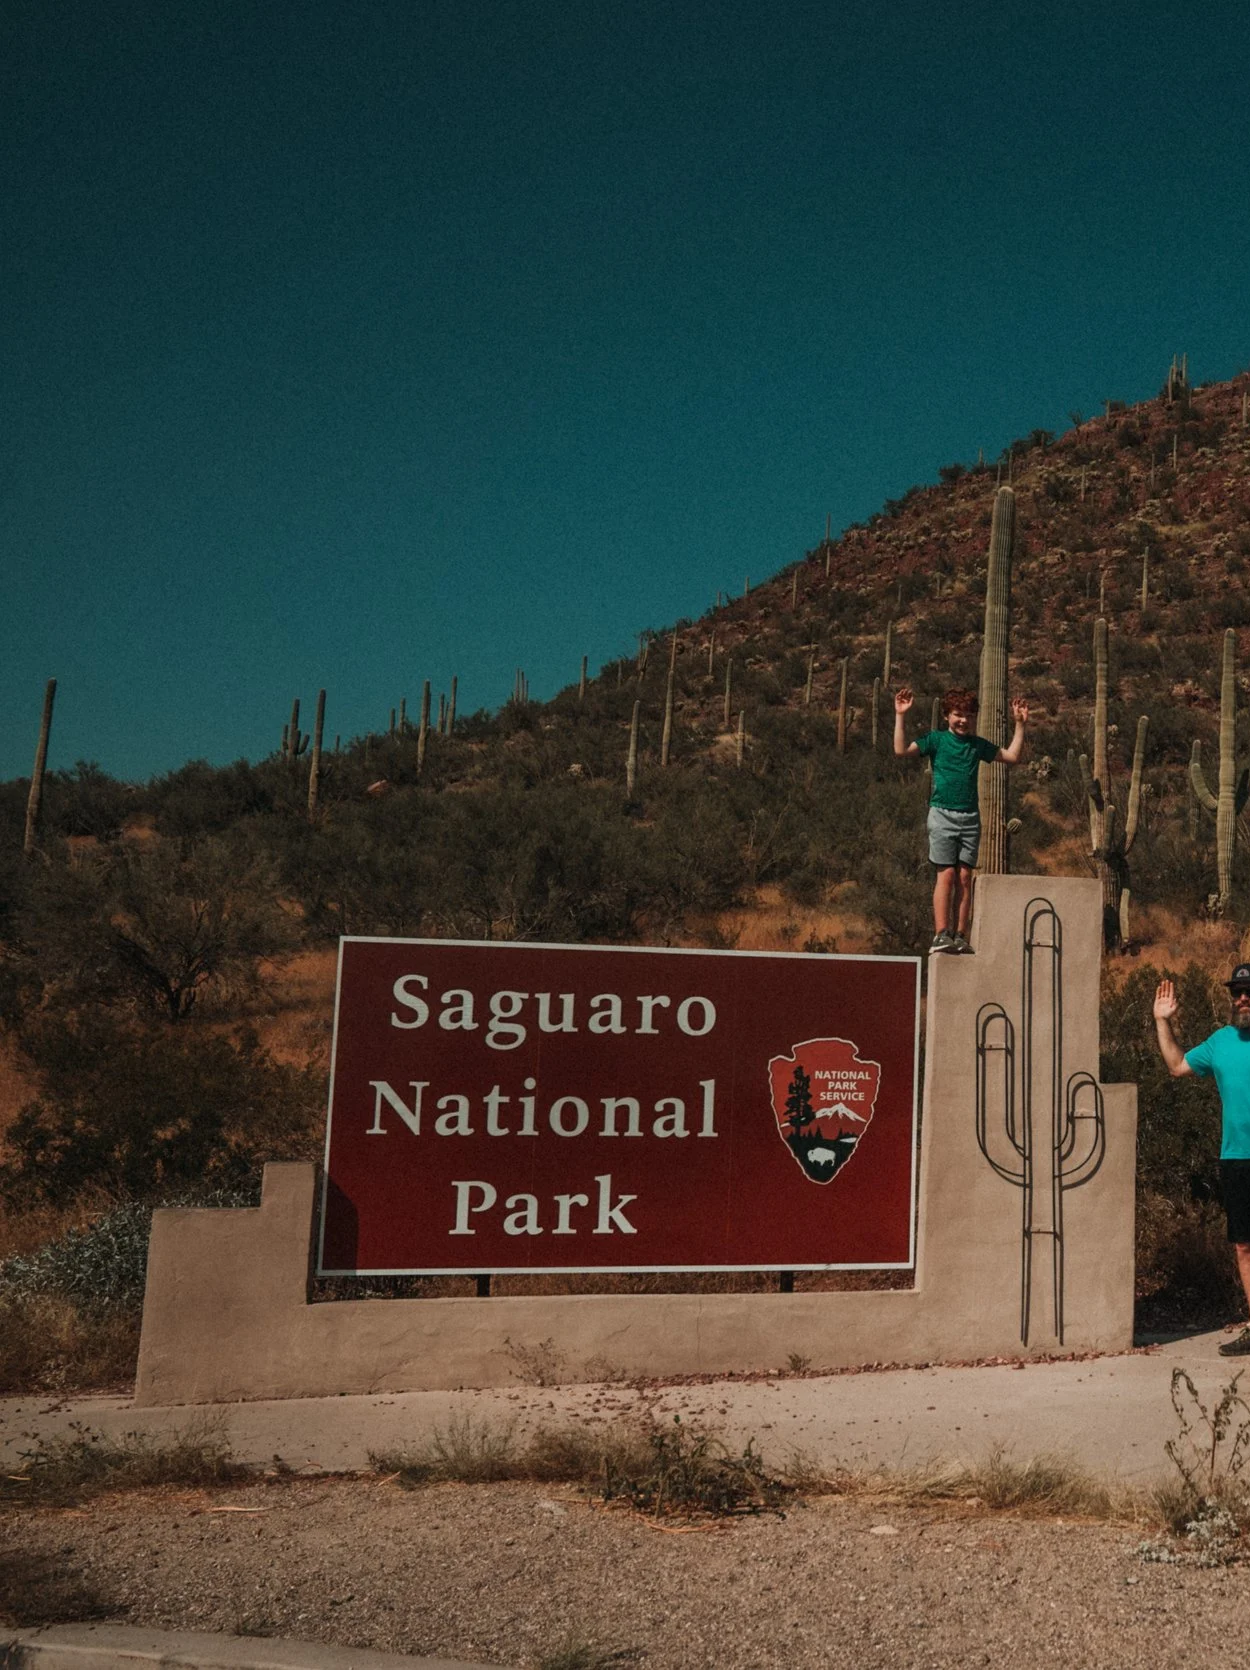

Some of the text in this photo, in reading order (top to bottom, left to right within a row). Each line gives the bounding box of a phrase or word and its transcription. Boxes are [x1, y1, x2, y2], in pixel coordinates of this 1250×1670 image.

[391, 974, 717, 1050] Saguaro
[814, 1070, 871, 1080] NATIONAL
[828, 1081, 857, 1090] PARK
[366, 1077, 719, 1138] National
[819, 1092, 865, 1101] SERVICE
[448, 1174, 638, 1236] Park
